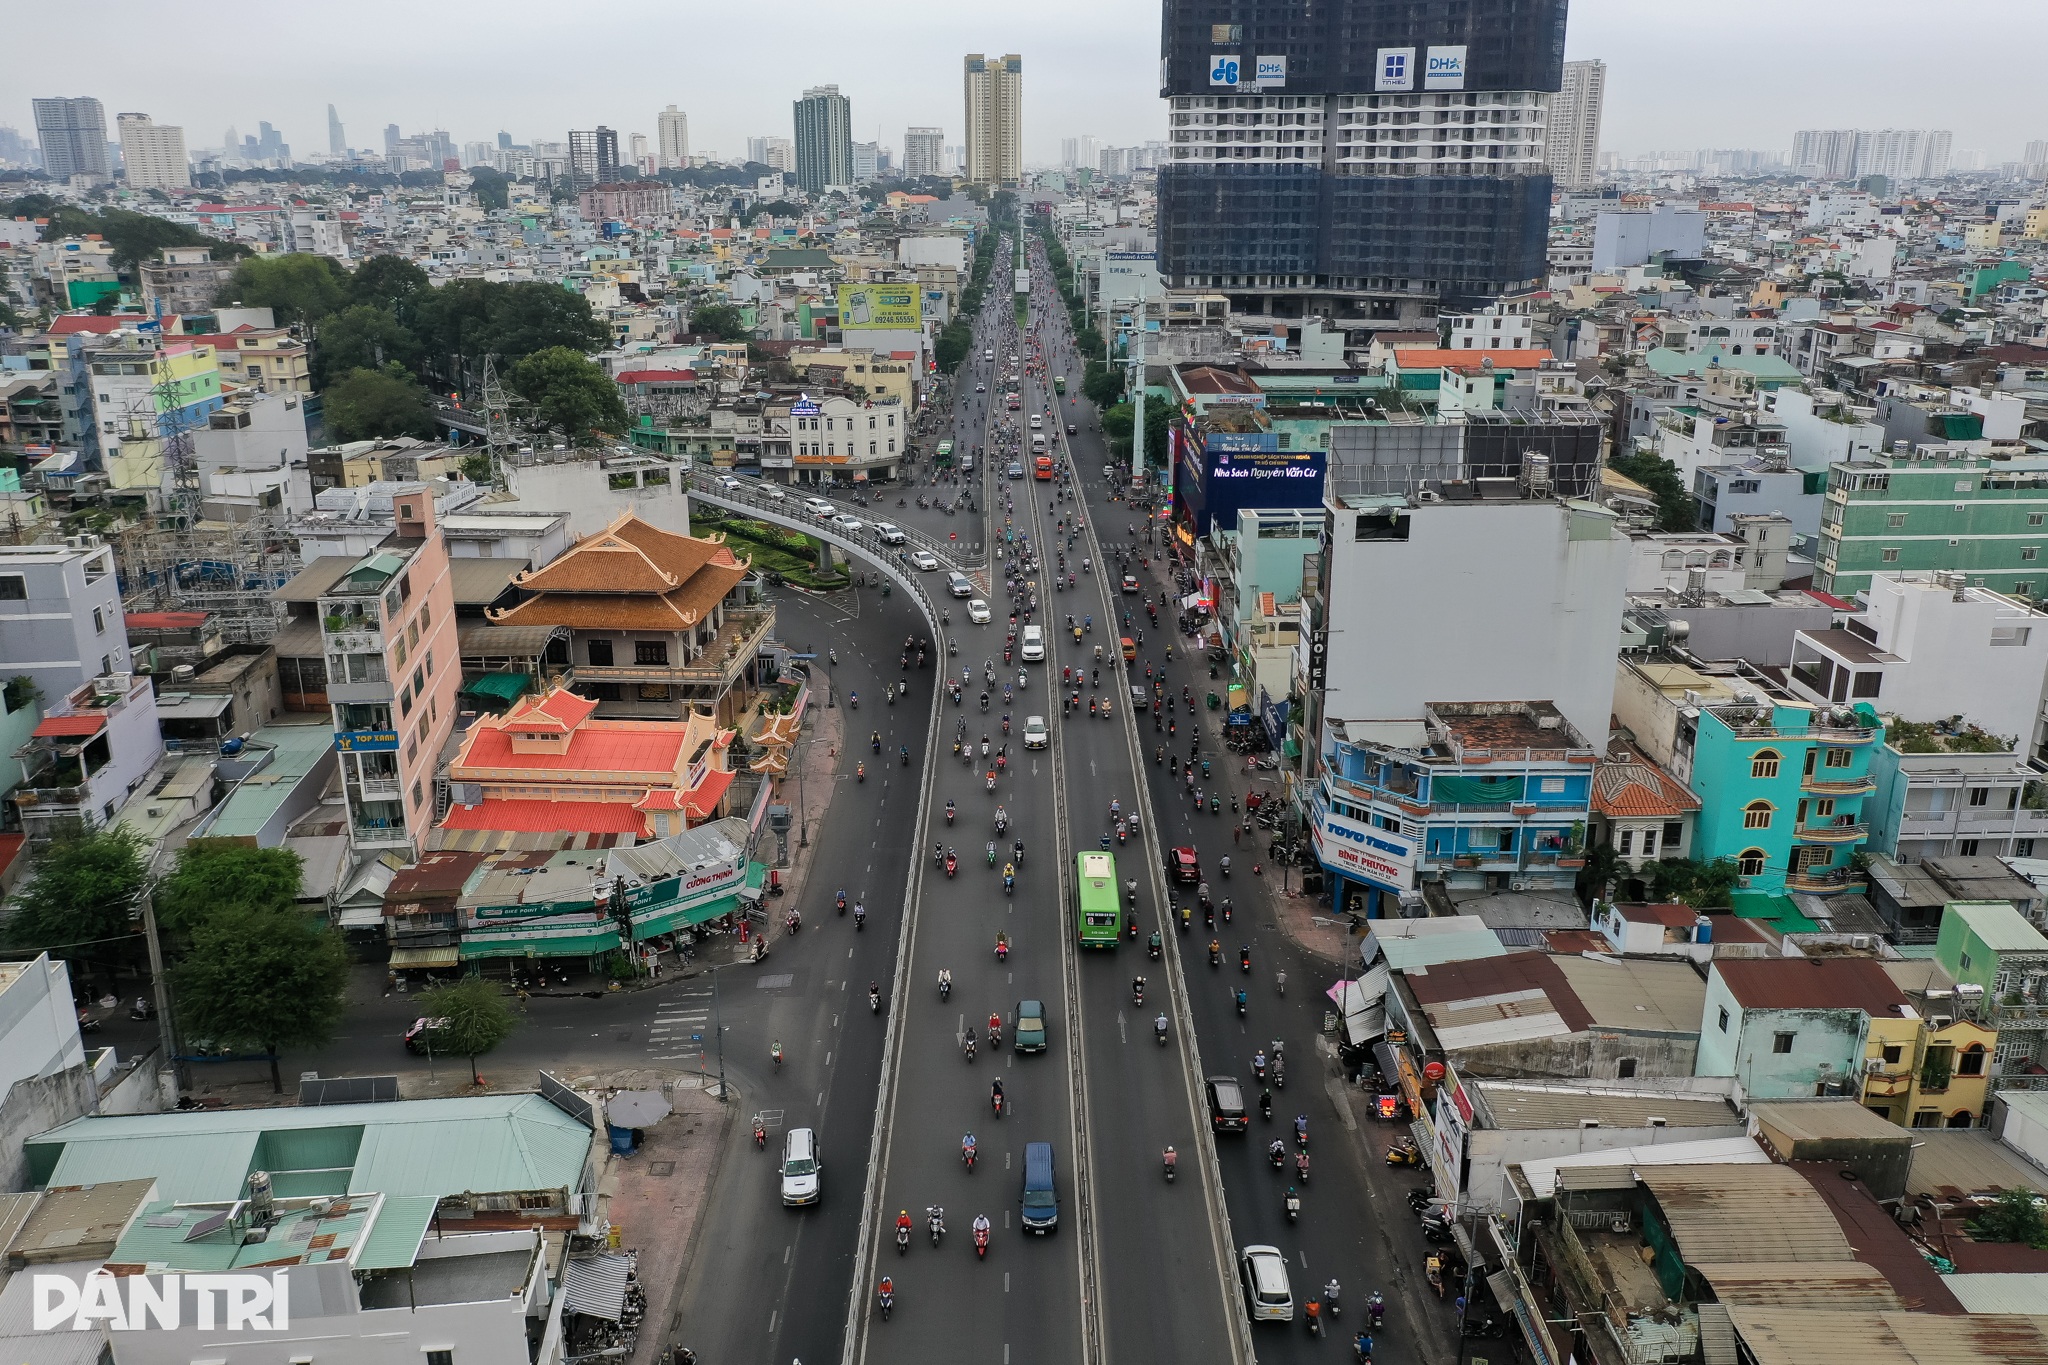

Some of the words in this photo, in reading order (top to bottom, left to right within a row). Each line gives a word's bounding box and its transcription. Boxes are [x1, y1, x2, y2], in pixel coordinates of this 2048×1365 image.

[1214, 467, 1230, 477] Nhà
[1231, 467, 1249, 477] Sách
[1312, 631, 1323, 690] HOTEL
[1327, 822, 1365, 843] TOYO
[1365, 835, 1408, 857] TIRES
[1338, 849, 1358, 863] BÌNH
[1361, 857, 1398, 877] PHƯƠNG
[686, 875, 711, 890] CƯỜNG
[712, 868, 733, 881] THỊNH
[632, 896, 652, 906] POINT
